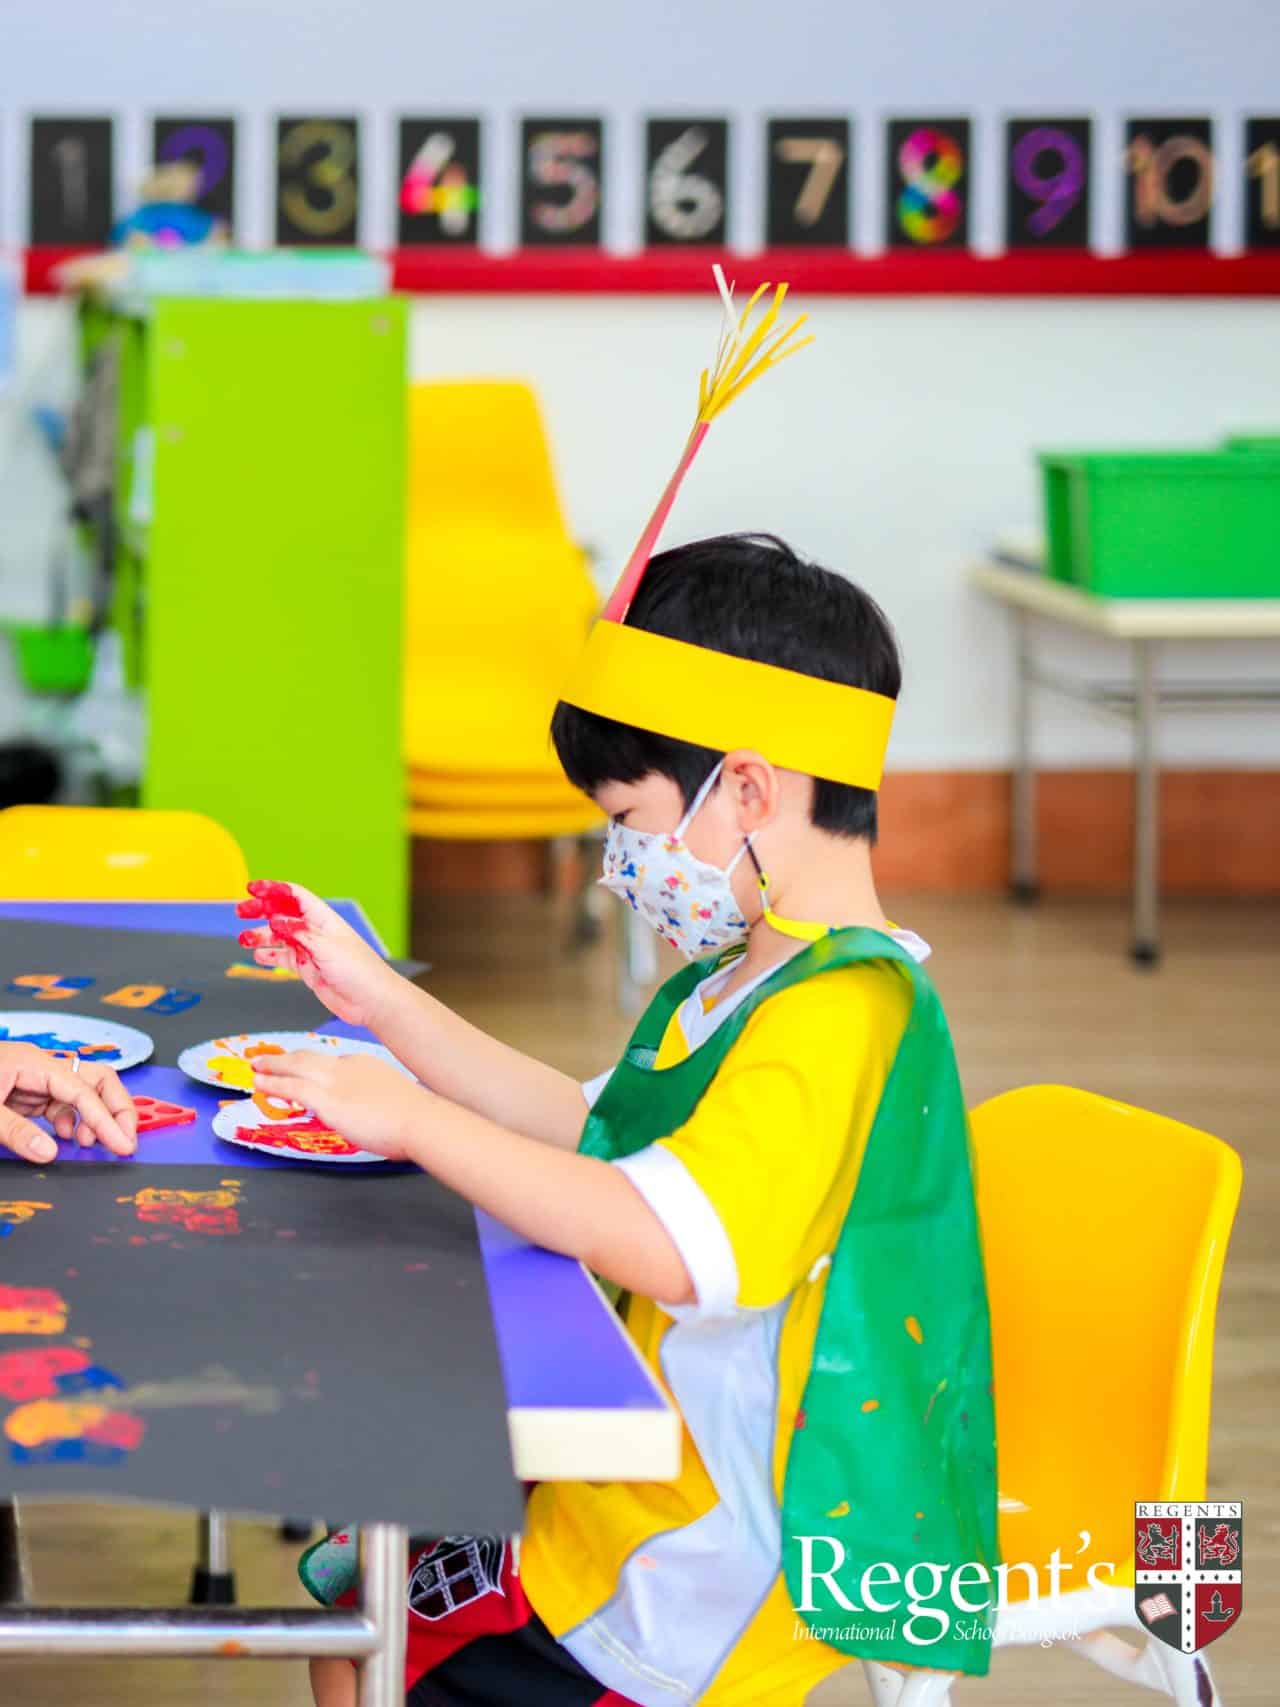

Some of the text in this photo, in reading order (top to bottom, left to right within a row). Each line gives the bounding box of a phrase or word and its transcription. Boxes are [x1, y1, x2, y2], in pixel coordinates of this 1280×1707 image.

[279, 121, 358, 234] 3
[401, 132, 480, 237] 4
[528, 131, 598, 231] 5
[650, 126, 721, 240] 6
[777, 137, 844, 228] 7
[898, 127, 963, 245] 8
[1013, 127, 1083, 237] 9
[1124, 134, 1215, 229] 10
[1247, 141, 1280, 230] 1
